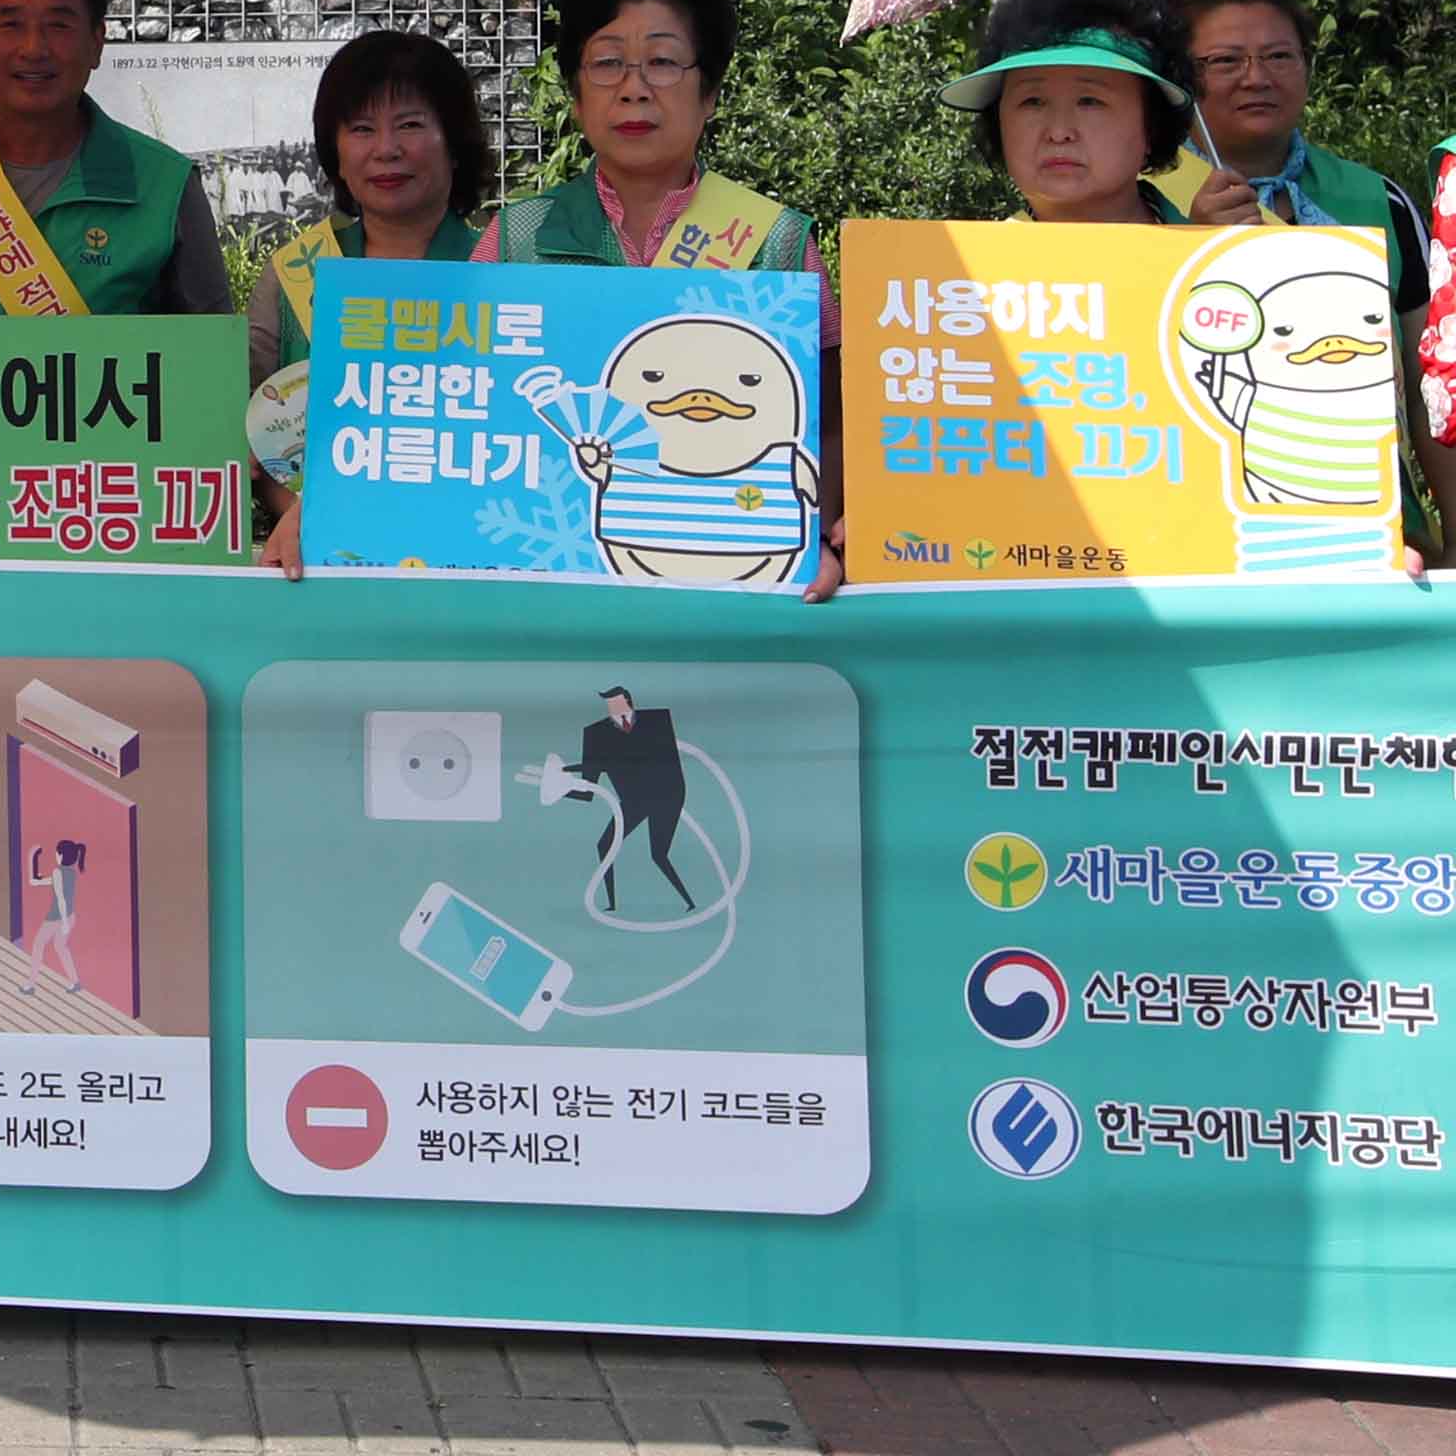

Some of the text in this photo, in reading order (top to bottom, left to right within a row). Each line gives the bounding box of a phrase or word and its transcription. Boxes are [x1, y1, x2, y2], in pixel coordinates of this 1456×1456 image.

[80, 252, 112, 267] SMU
[338, 297, 544, 356] 쿨맵시로
[878, 278, 1106, 341] 사용하지
[1194, 306, 1248, 333] OFF
[334, 362, 494, 420] 시원한
[879, 347, 1148, 411] 않는 조명,
[332, 426, 540, 489] 여름나기
[880, 415, 1185, 484] 컴퓨터 끄기
[7, 461, 139, 552] 조명등
[153, 461, 241, 554] 끄기
[884, 531, 950, 564] SMU
[1003, 545, 1128, 573] 새마을운동
[1083, 971, 1438, 1036] 산업통상자원부
[21, 1070, 66, 1101] 2도
[76, 1071, 166, 1104] 올리고
[417, 1080, 826, 1127] 사용하지 않는 전기 코드들을
[417, 1129, 581, 1167] 뽑아주세요!
[1095, 1102, 1443, 1171] 한국에너지공단
